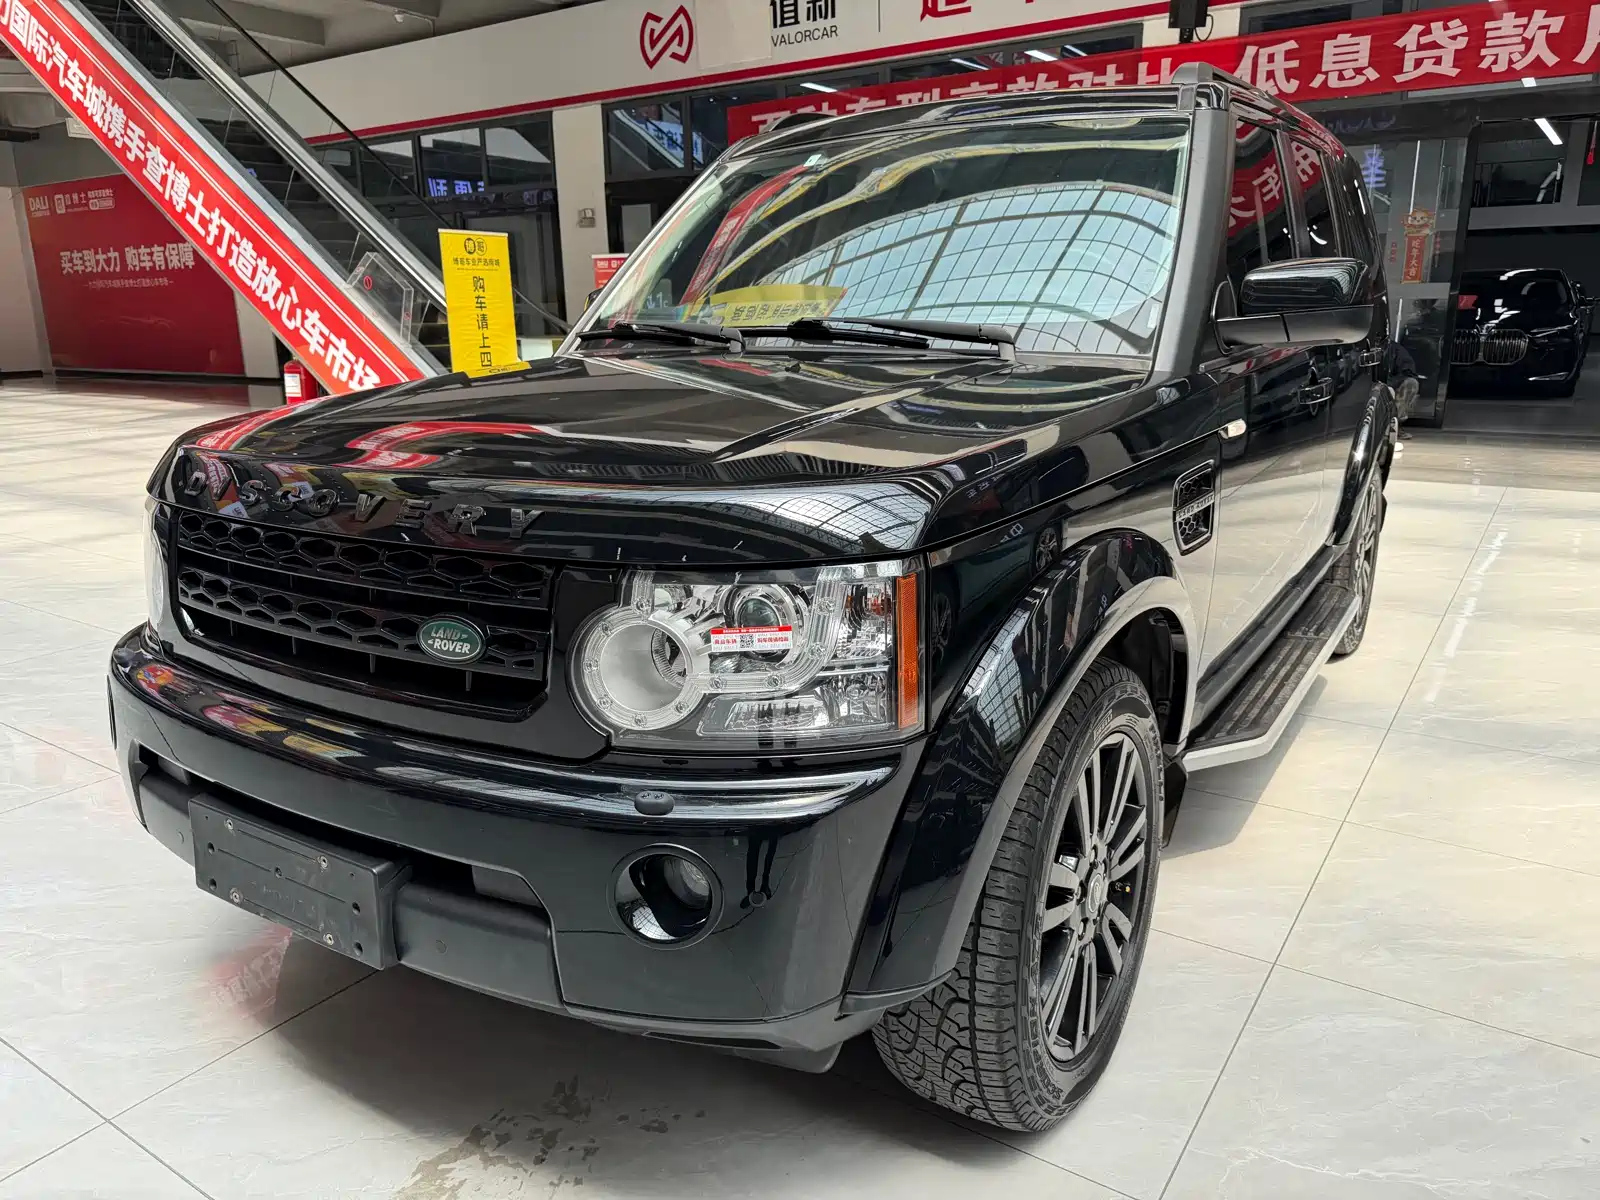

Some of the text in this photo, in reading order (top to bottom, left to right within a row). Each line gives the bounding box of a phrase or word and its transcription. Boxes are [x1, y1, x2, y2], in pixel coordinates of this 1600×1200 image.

[771, 26, 838, 46] VALORCAR
[60, 242, 196, 275] 买车到大力 购车有保障
[472, 276, 493, 367] 购车请上四
[184, 471, 544, 538] DISCOVERY
[431, 626, 461, 640] LAND
[433, 639, 471, 654] ROVER
